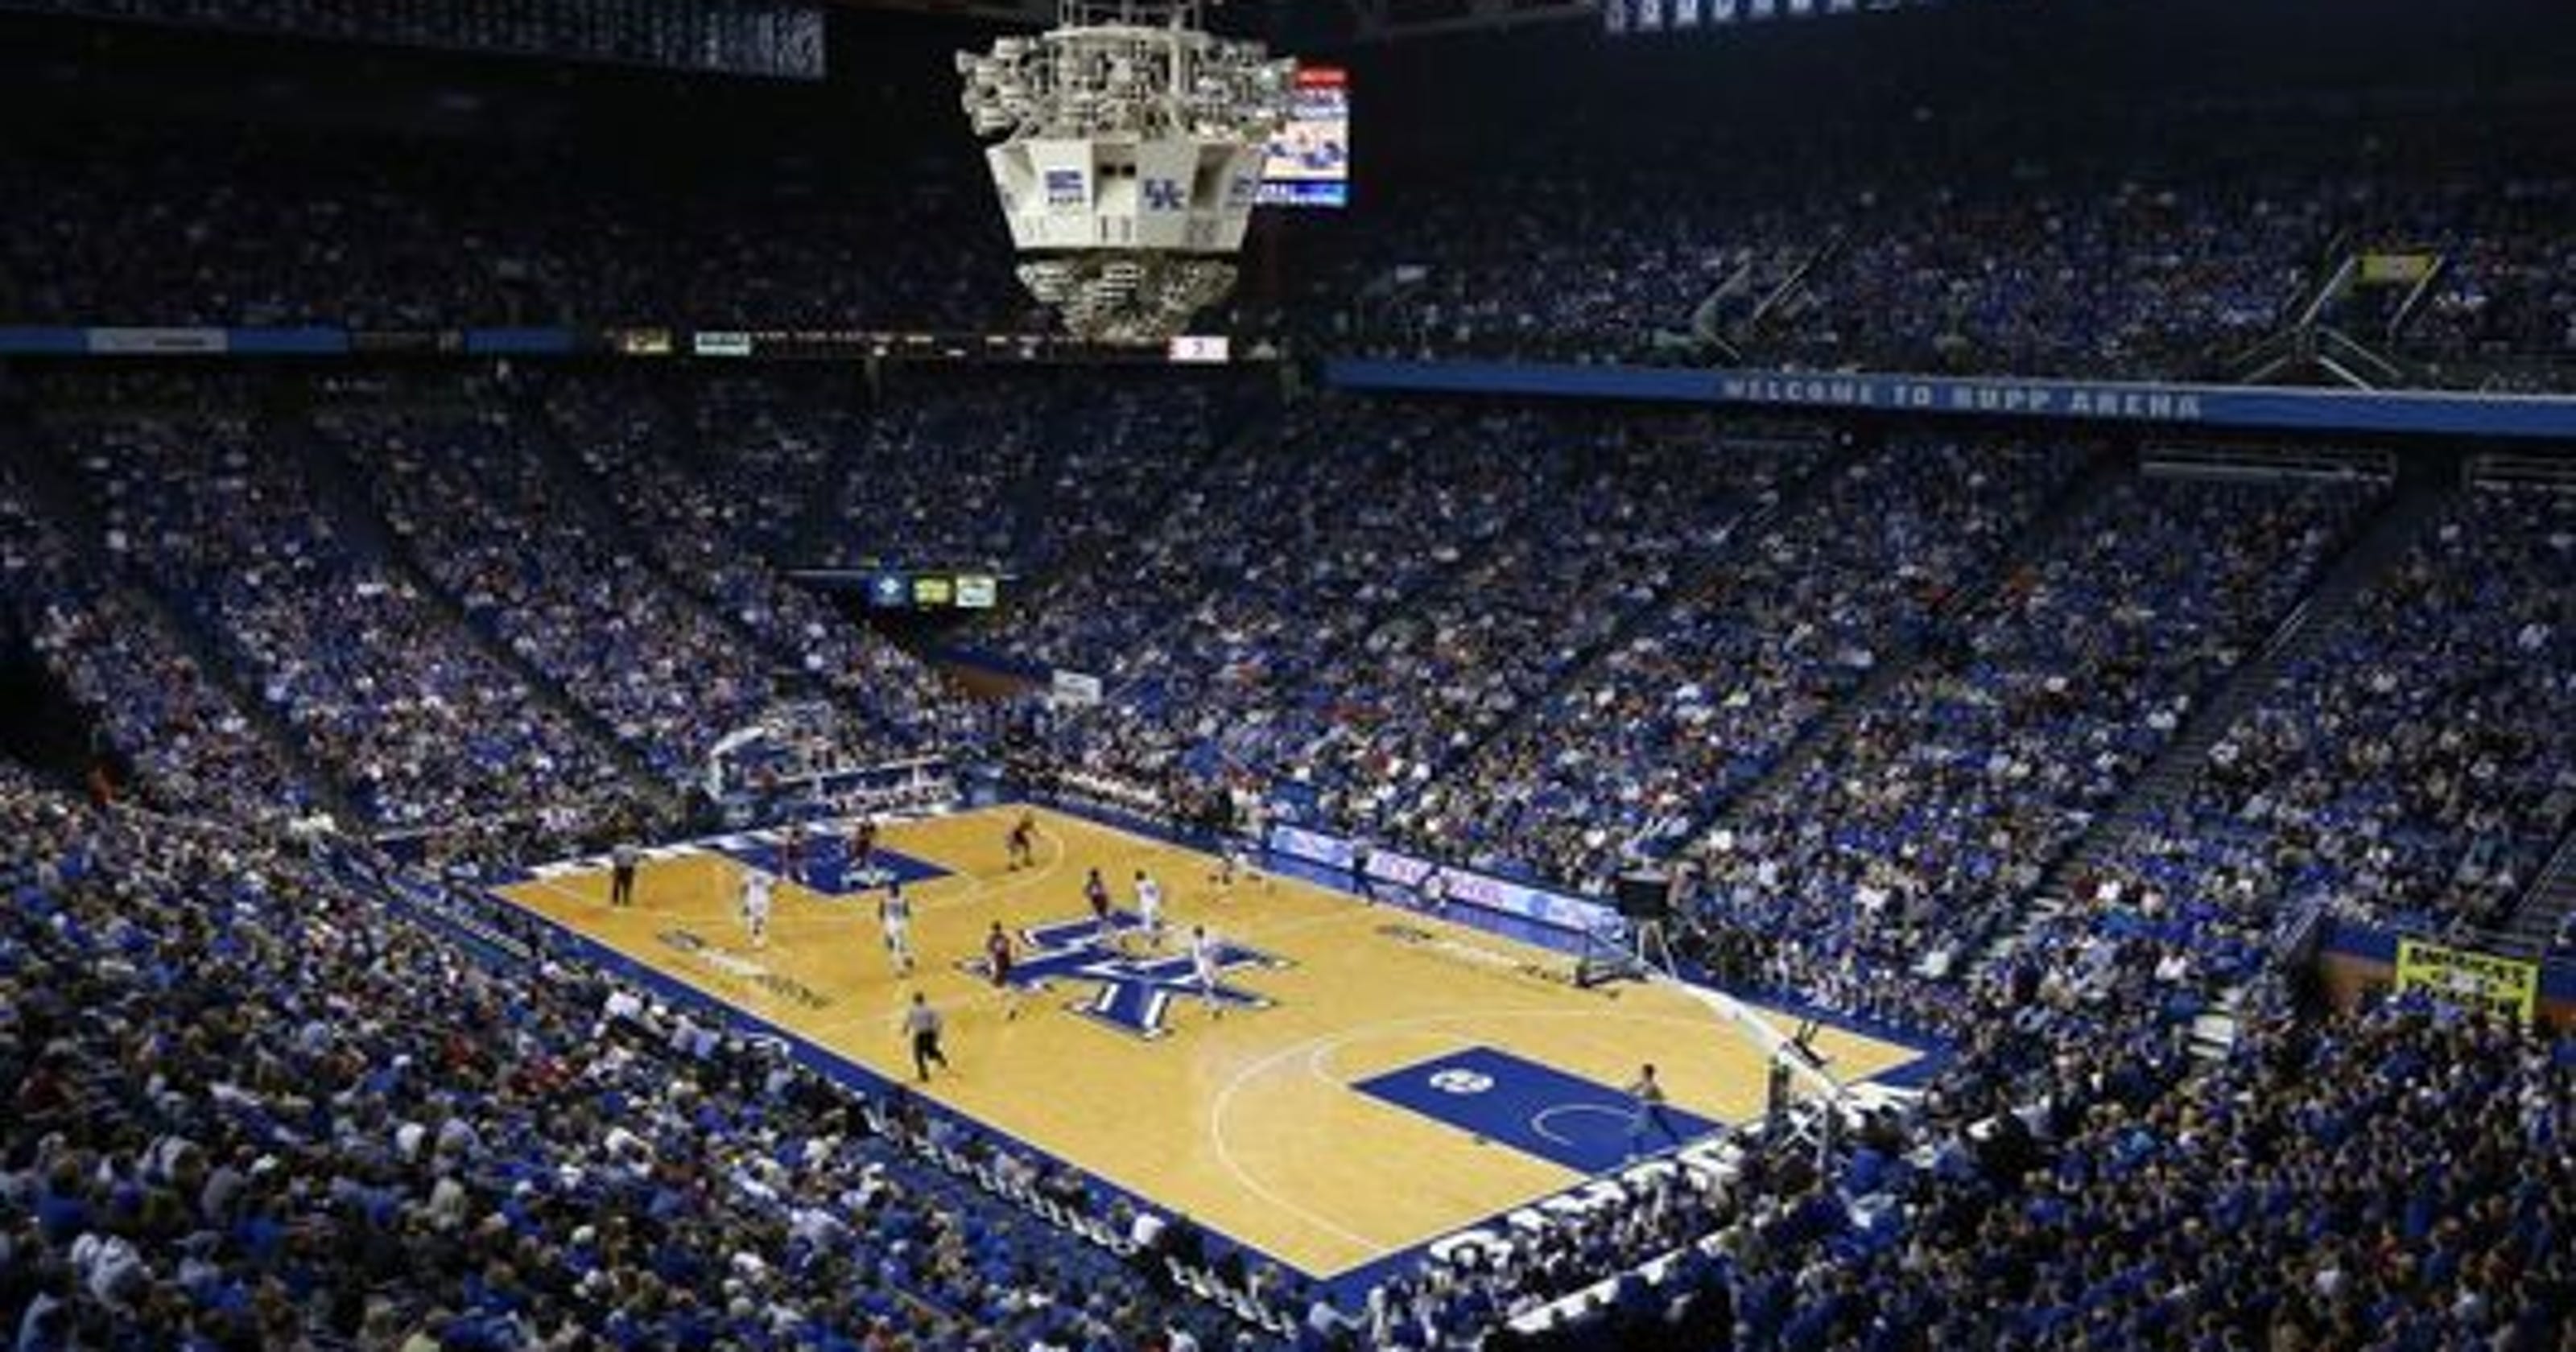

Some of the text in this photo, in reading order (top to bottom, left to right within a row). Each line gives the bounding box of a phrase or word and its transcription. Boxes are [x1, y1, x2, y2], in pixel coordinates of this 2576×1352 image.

[1724, 380, 2201, 418] WELCOME TO RUPP ARENA
